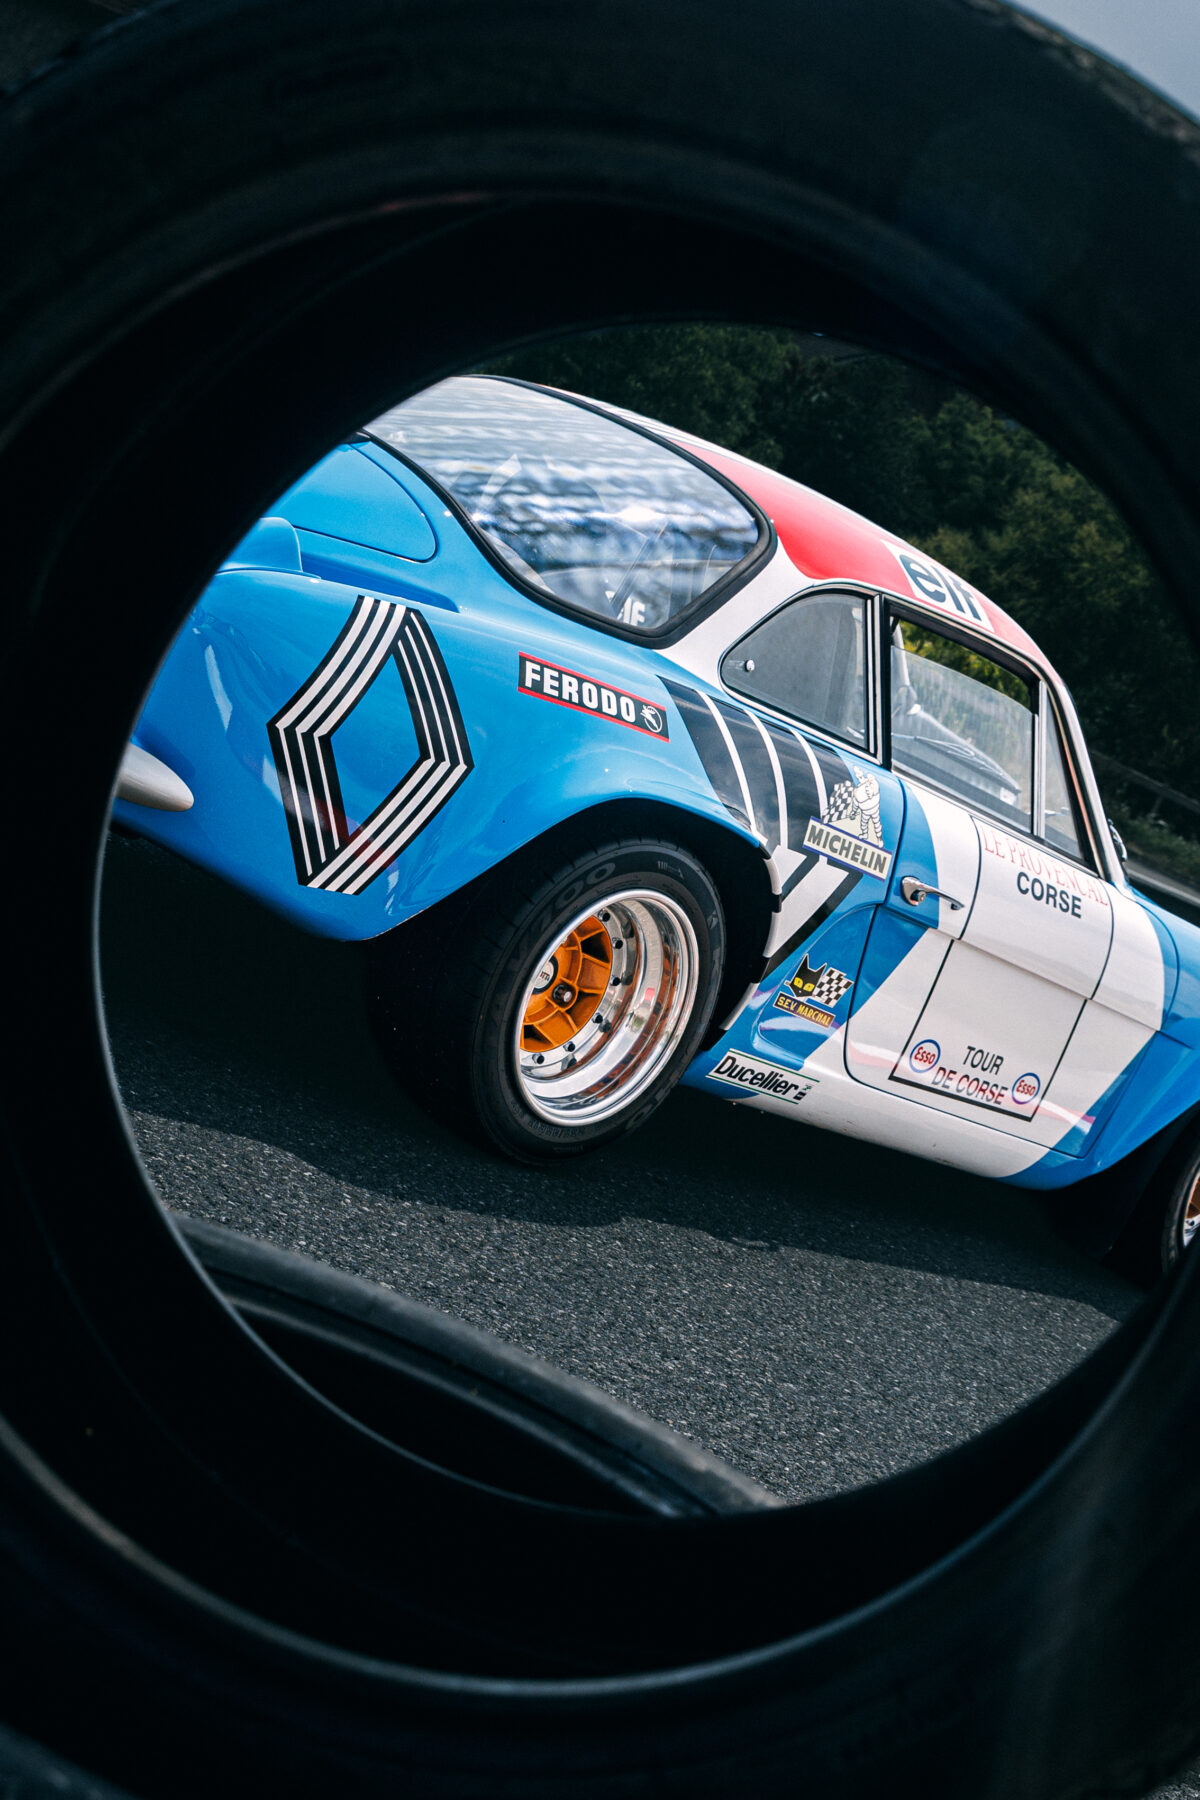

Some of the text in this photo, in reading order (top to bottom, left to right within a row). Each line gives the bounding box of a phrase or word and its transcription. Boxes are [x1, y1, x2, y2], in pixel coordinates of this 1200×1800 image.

[899, 554, 983, 622] elf
[525, 660, 637, 723] FERODO
[806, 824, 888, 874] MICHELIN
[981, 825, 1006, 859] LE
[1016, 871, 1082, 918] CORSE
[796, 1004, 831, 1027] MARCHAL
[714, 1055, 800, 1096] Ducellier
[963, 1046, 1004, 1075] TOUR
[931, 1067, 1008, 1105] DE CORSE
